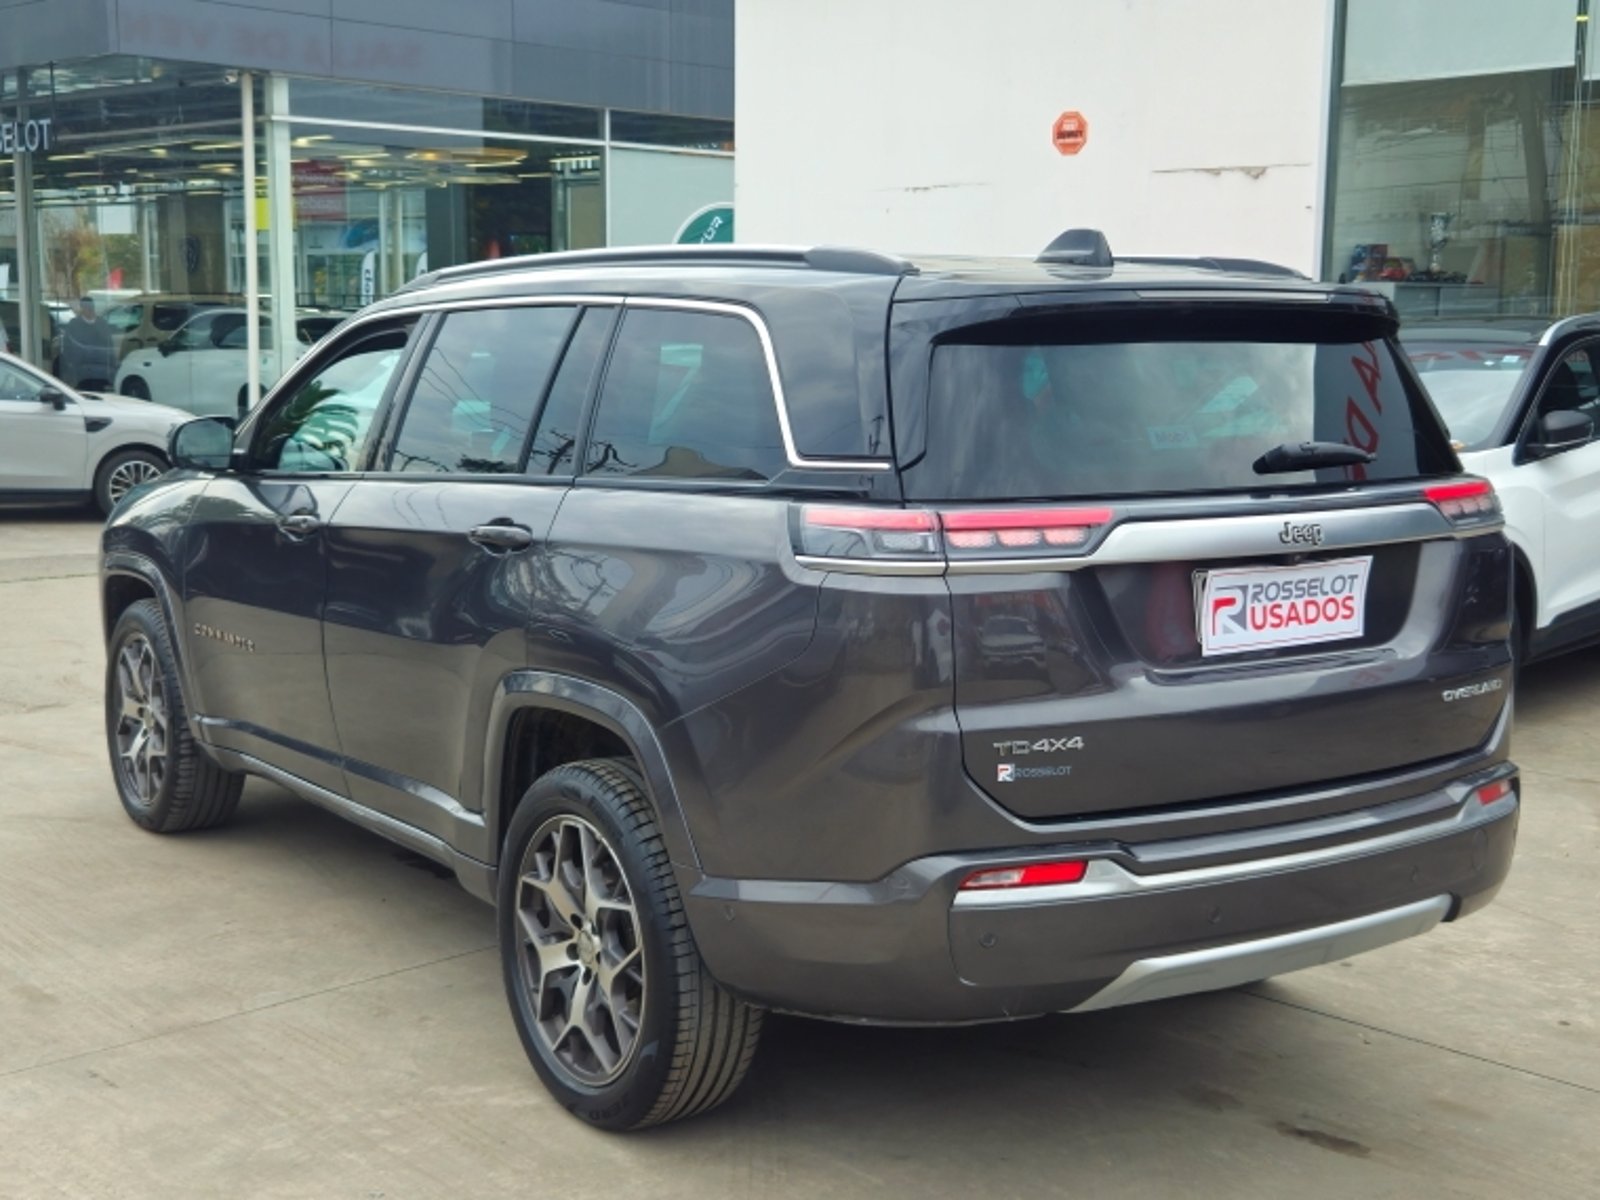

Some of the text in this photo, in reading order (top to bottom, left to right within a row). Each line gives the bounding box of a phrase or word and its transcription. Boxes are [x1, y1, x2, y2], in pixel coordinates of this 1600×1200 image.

[0, 118, 51, 154] ELOT
[1279, 521, 1322, 546] Jeep
[1251, 574, 1359, 604] ROSSELOT
[1250, 596, 1355, 631] USADOS
